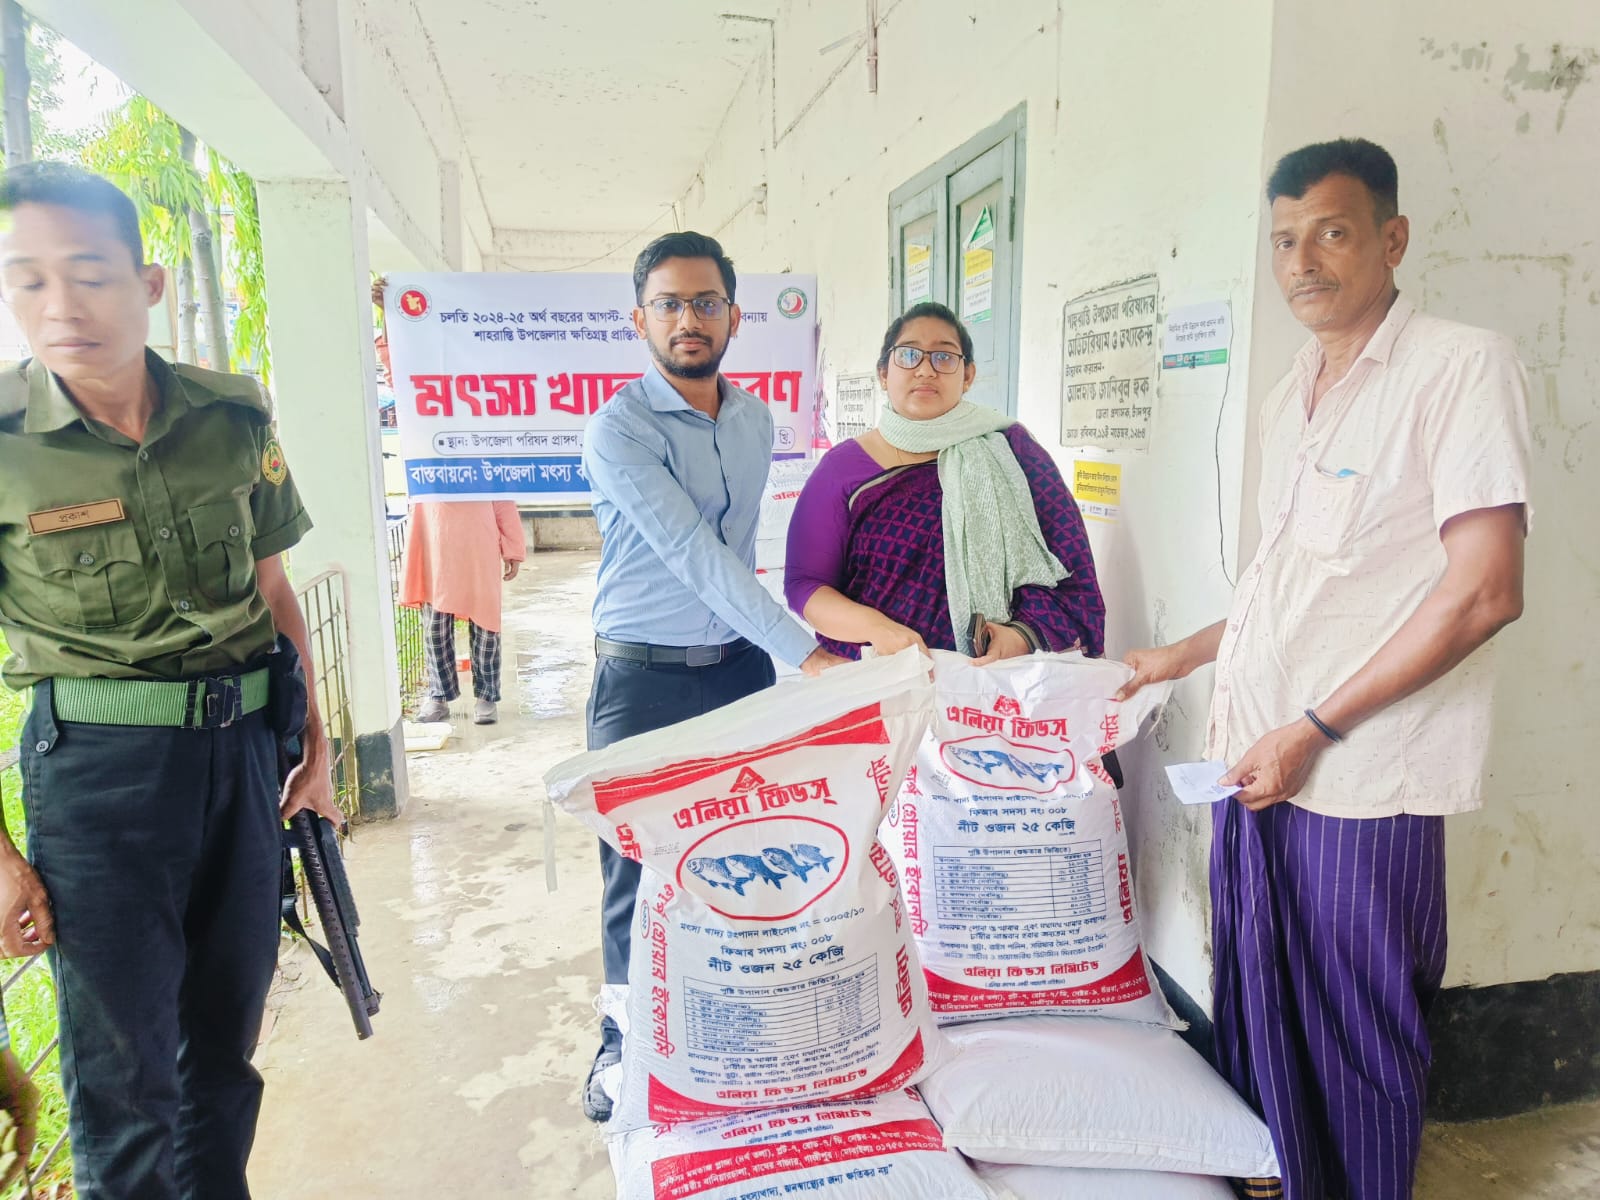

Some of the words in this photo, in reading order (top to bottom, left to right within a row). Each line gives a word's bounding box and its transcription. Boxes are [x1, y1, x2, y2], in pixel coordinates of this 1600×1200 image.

[440, 309, 469, 323] চলতি
[473, 312, 525, 323] ২০২৪-২৫
[529, 308, 547, 323] অর্থ
[551, 312, 583, 323] বছরের
[517, 327, 566, 341] উপজেলার
[410, 373, 536, 416] মৎস্য
[447, 435, 468, 449] স্থান:
[472, 434, 512, 447] উপজেলা
[516, 433, 547, 447] পরিষদ
[409, 464, 478, 484] বাস্তবায়নে:
[481, 459, 535, 483] উপজেলা
[539, 463, 572, 482] মৎস্য
[947, 706, 1006, 733] এলিয়া
[1010, 717, 1070, 743] ফিডস্
[673, 795, 750, 829] এলিয়া
[756, 777, 838, 812] ফিডস্
[1002, 807, 1027, 816] সদস্য
[957, 819, 979, 833] নীট
[984, 823, 1016, 833] ওজন
[1021, 822, 1039, 833] ২৫
[1045, 818, 1076, 832] কেজি
[903, 865, 928, 938] ইকোনমি
[708, 956, 733, 973] নীট
[739, 962, 775, 974] ওজন
[783, 959, 804, 970] ২৫
[809, 944, 845, 965] কেজি
[757, 945, 786, 956] সদস্য
[963, 966, 1001, 979] এলিয়া
[1007, 966, 1045, 977] ফিডস
[1051, 961, 1099, 974] লিমিটেড
[651, 985, 676, 1059] ইকোনমি
[716, 1086, 758, 1099] এলিয়া
[764, 1083, 807, 1097] ফিডস
[813, 1067, 868, 1089] লিমিটেড
[721, 1123, 763, 1140] এলিয়া
[768, 1116, 810, 1129] ফিডস
[816, 1109, 872, 1121] লিমিটেড
[827, 1174, 843, 1185] জন্য
[846, 1168, 875, 1181] ক্ষতিকর
